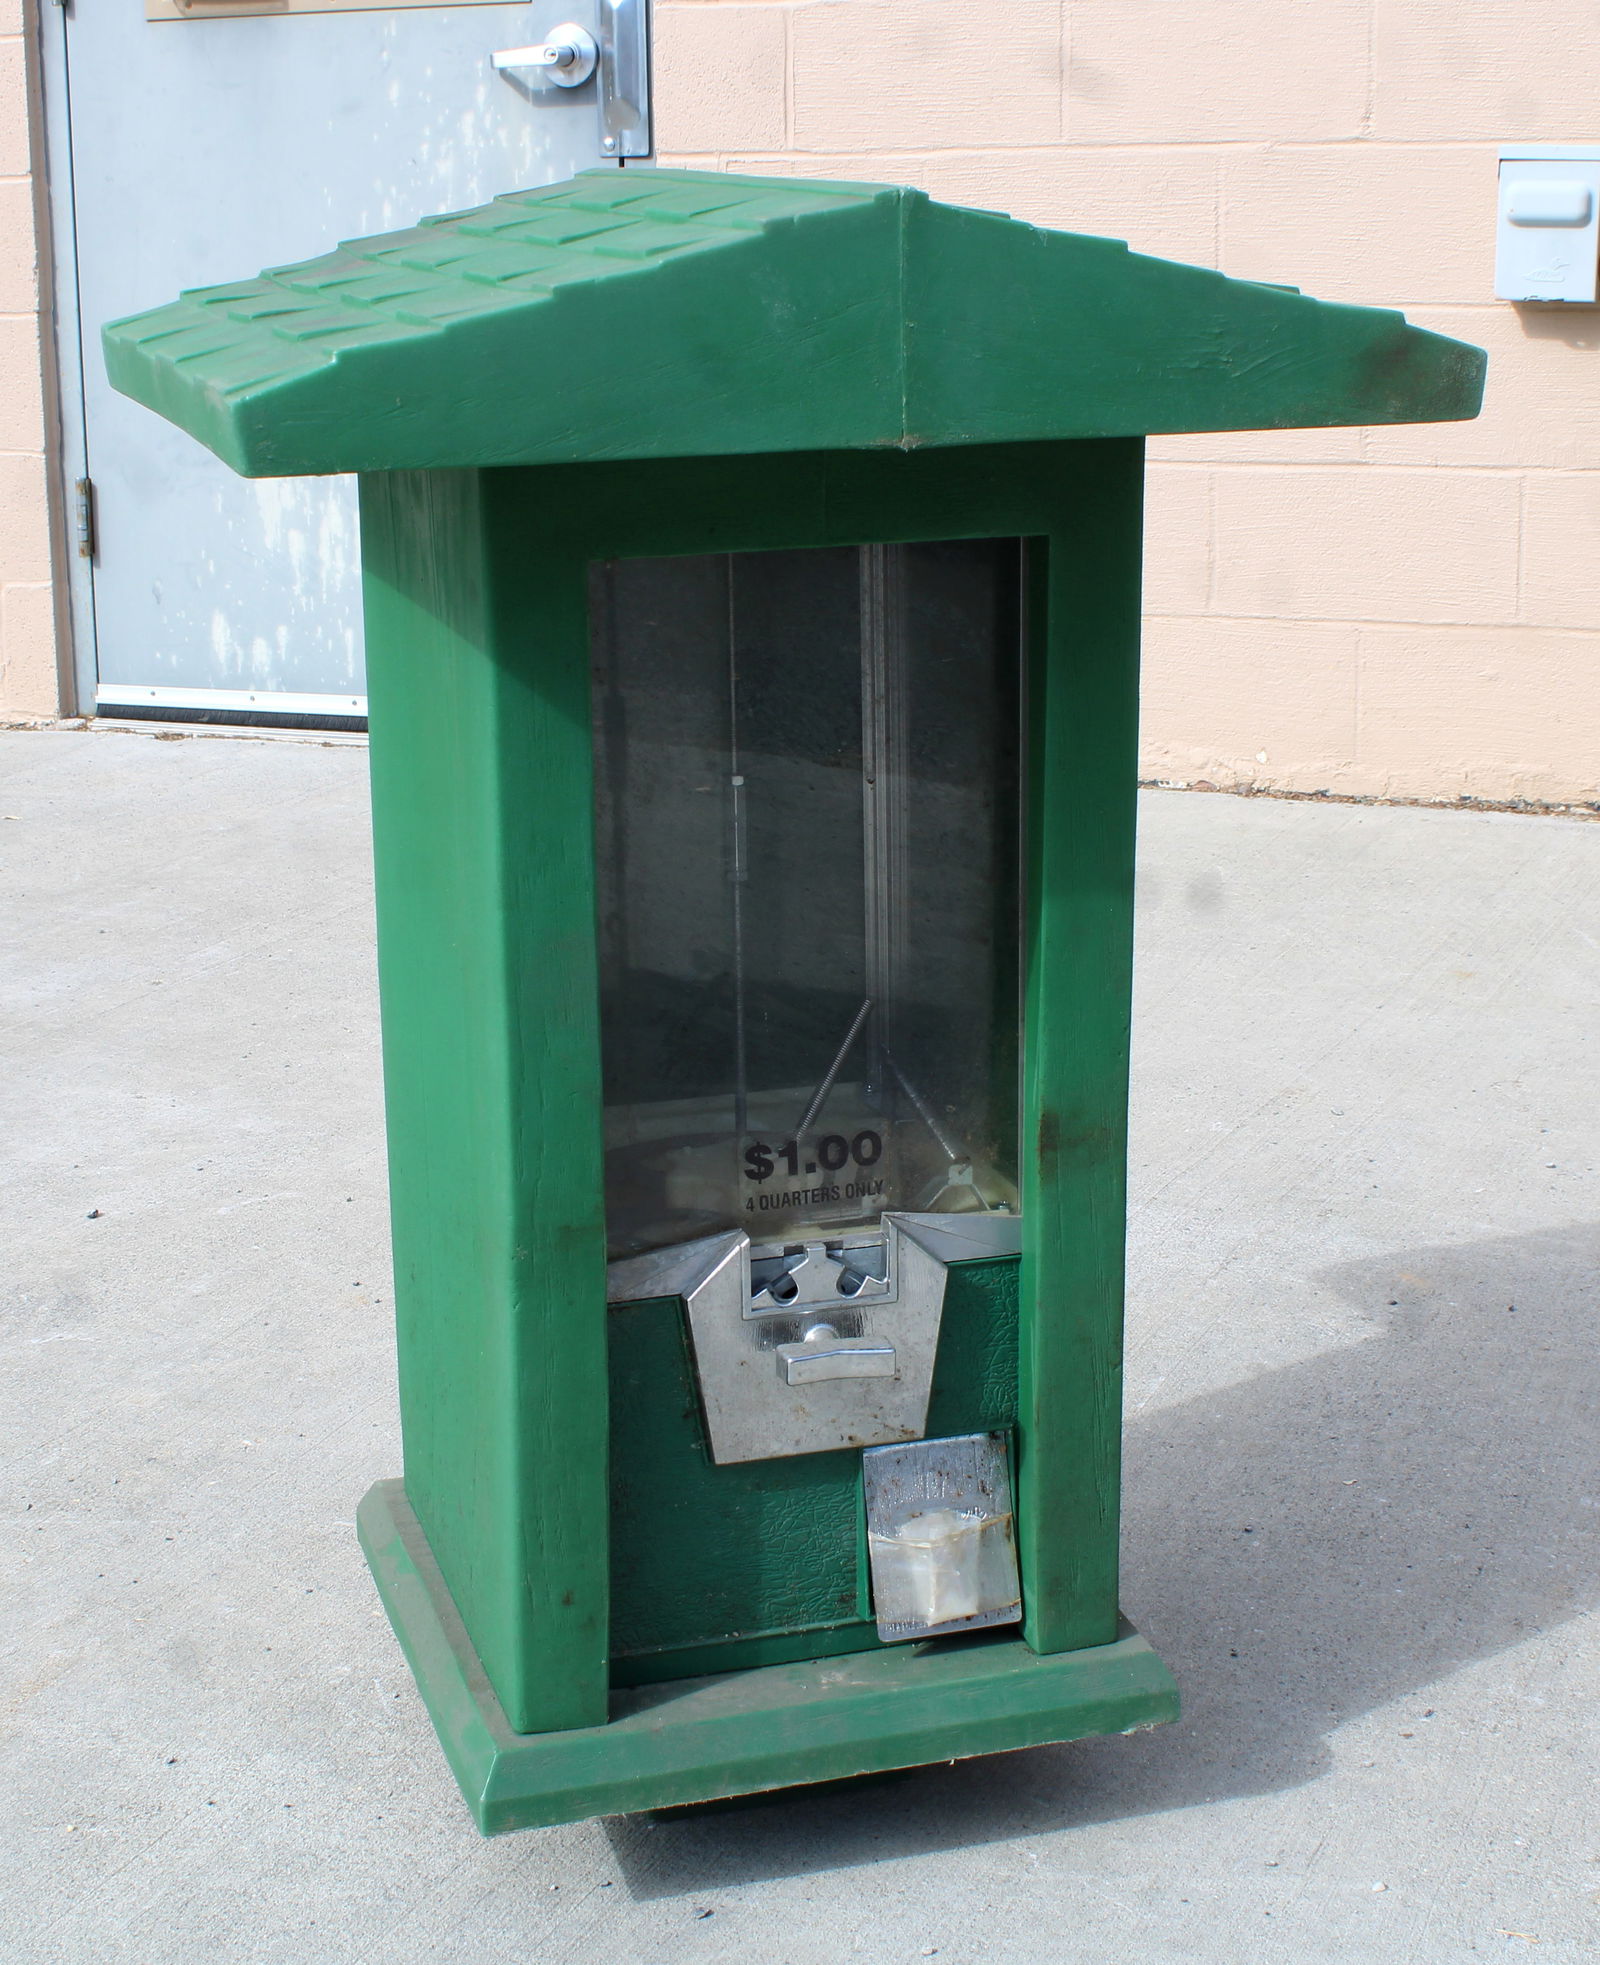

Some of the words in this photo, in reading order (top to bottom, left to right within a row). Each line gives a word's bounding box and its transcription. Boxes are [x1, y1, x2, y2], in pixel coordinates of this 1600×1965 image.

[744, 1130, 882, 1184] $1.00
[746, 1197, 755, 1212] 4
[759, 1185, 840, 1210] QUARTERS
[846, 1180, 884, 1199] ONLY
